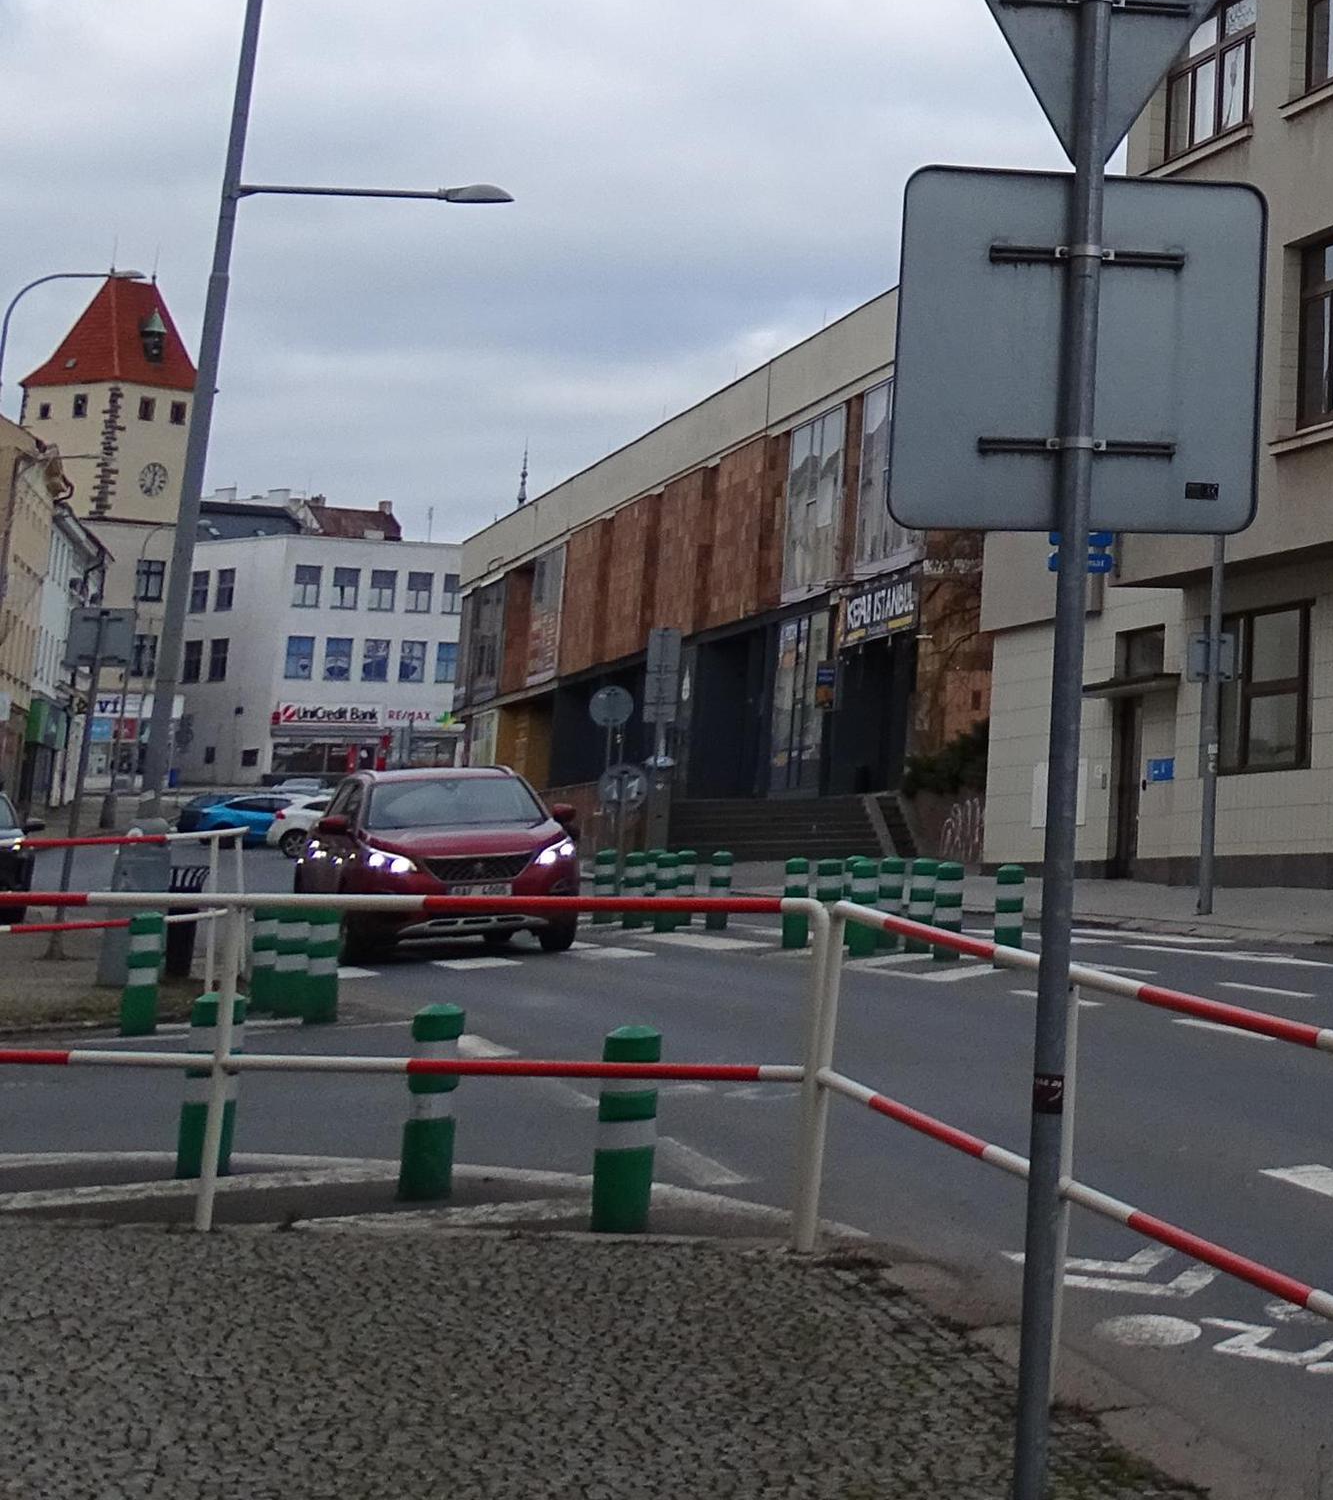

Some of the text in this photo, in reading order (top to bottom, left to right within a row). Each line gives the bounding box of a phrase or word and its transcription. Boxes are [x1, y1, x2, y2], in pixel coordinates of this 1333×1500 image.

[297, 705, 379, 721] UniCredit Bank
[387, 709, 432, 721] RE/MAX
